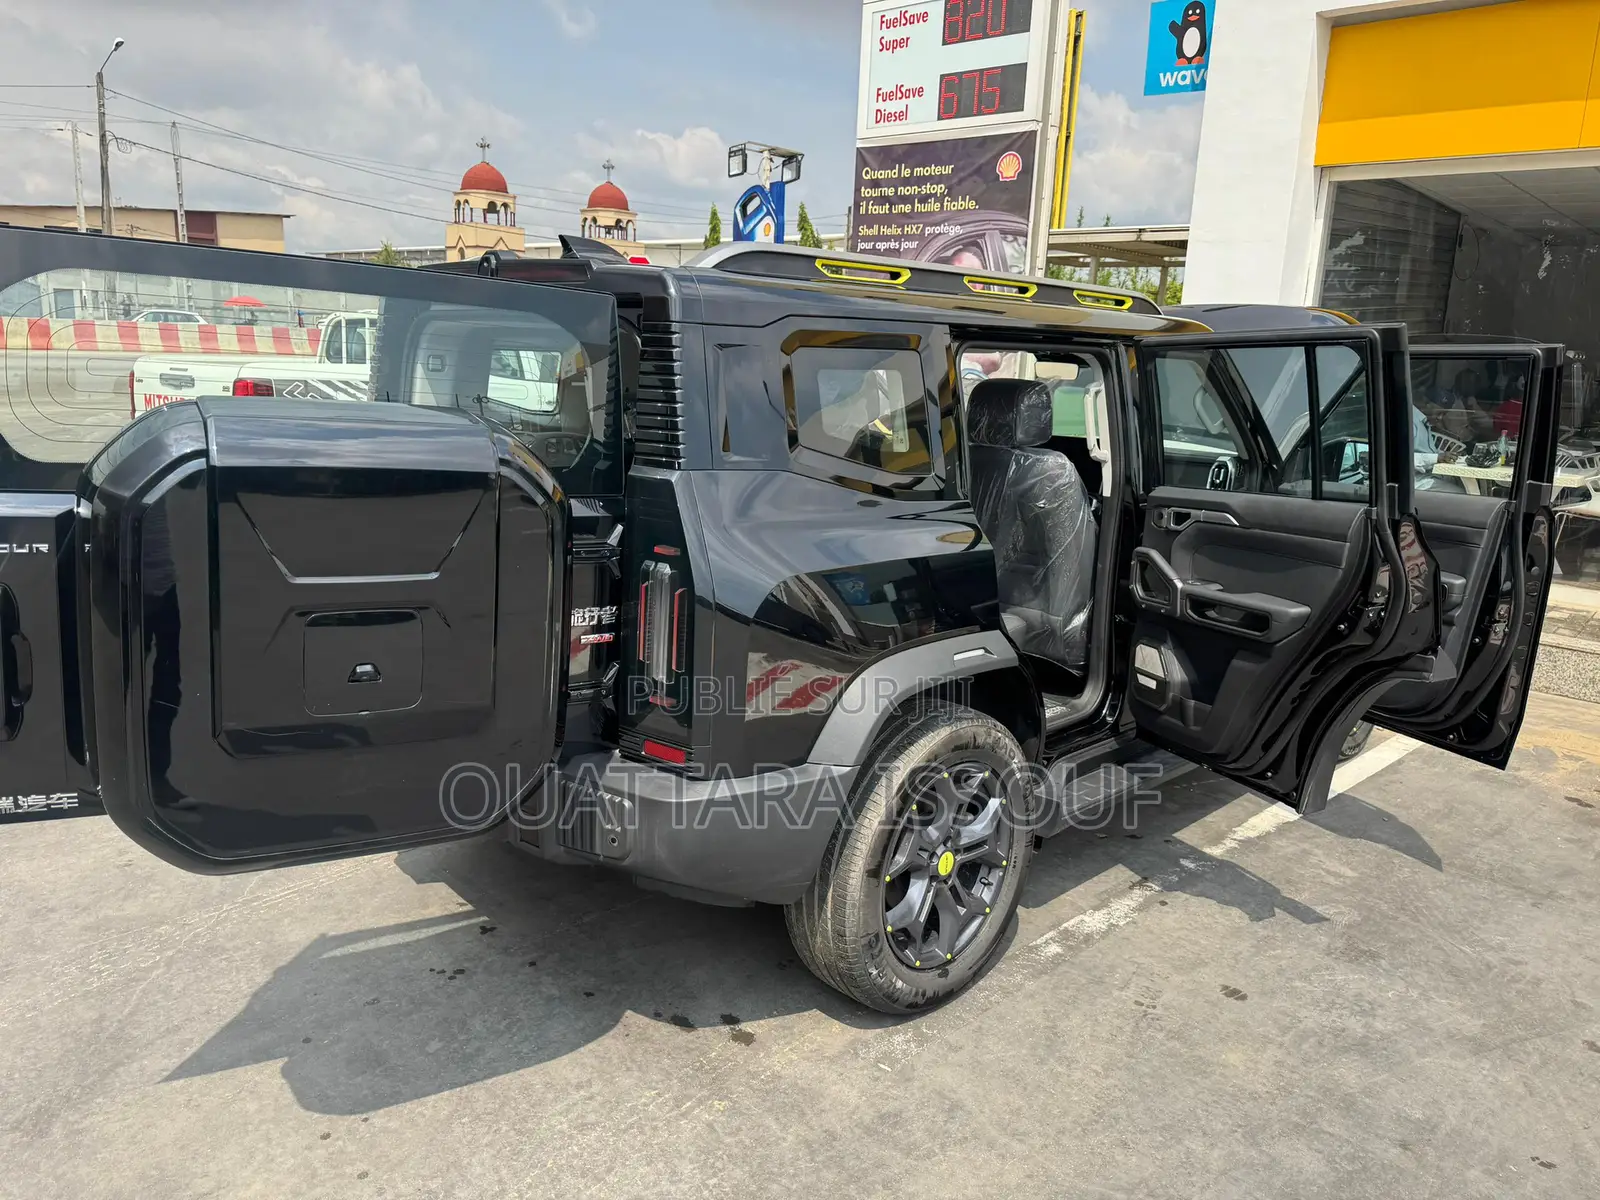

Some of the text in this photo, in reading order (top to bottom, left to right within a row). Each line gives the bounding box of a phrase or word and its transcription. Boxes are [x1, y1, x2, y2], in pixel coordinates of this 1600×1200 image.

[880, 10, 929, 31] FuelSave
[944, 0, 1007, 44] 820
[879, 36, 911, 54] Super
[876, 84, 925, 103] FuelSave
[940, 68, 1002, 119] 675
[875, 104, 909, 124] Diesel
[862, 163, 954, 180] Quand le moteur
[861, 183, 948, 197] tourne non-stop,
[860, 196, 979, 214] il faut une huile fiable.
[858, 223, 963, 236] Shell Helix HX7 protège,
[857, 237, 919, 252] jour après jour
